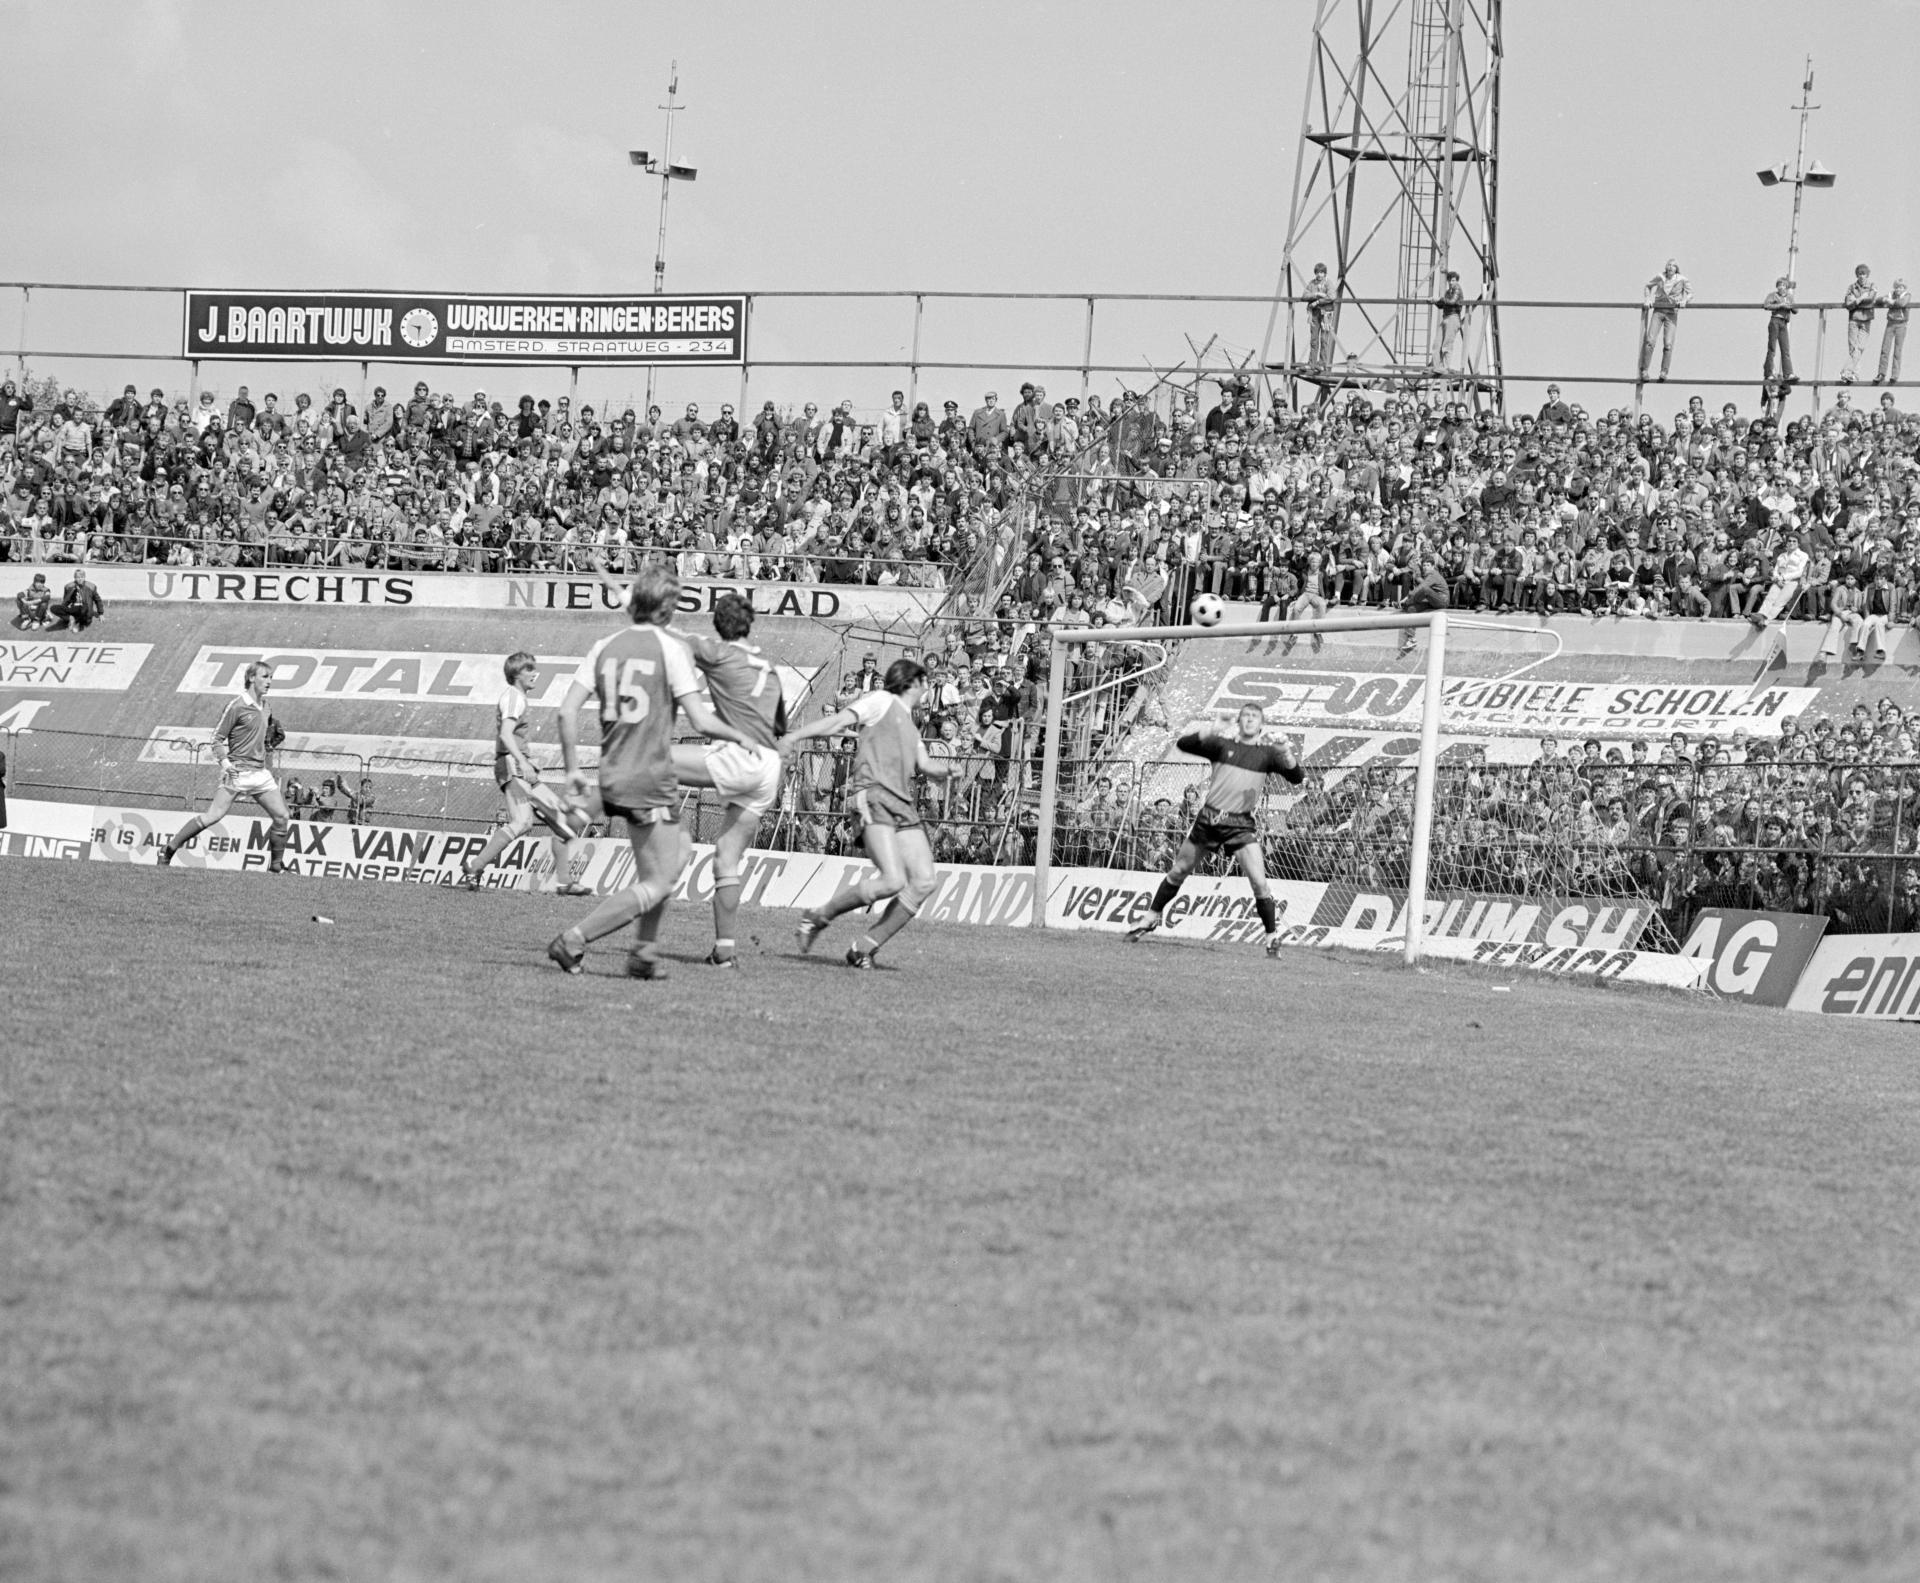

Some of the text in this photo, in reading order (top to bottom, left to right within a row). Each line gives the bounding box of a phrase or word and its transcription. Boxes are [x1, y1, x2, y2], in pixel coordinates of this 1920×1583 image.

[580, 306, 651, 333] RINGEN
[654, 306, 735, 333] BEKERS
[556, 341, 671, 353] STRAATWEG
[688, 340, 728, 352] 234
[147, 571, 841, 618] UTRECHTS NIEUSLAD
[0, 665, 72, 683] RN
[205, 652, 477, 697] TOTAL
[602, 657, 657, 724] 15
[747, 654, 773, 697] 7
[117, 829, 135, 845] IS
[143, 832, 198, 850] ALTD
[208, 836, 241, 853] EEN
[247, 820, 333, 856] MAX
[351, 828, 435, 865] VAN
